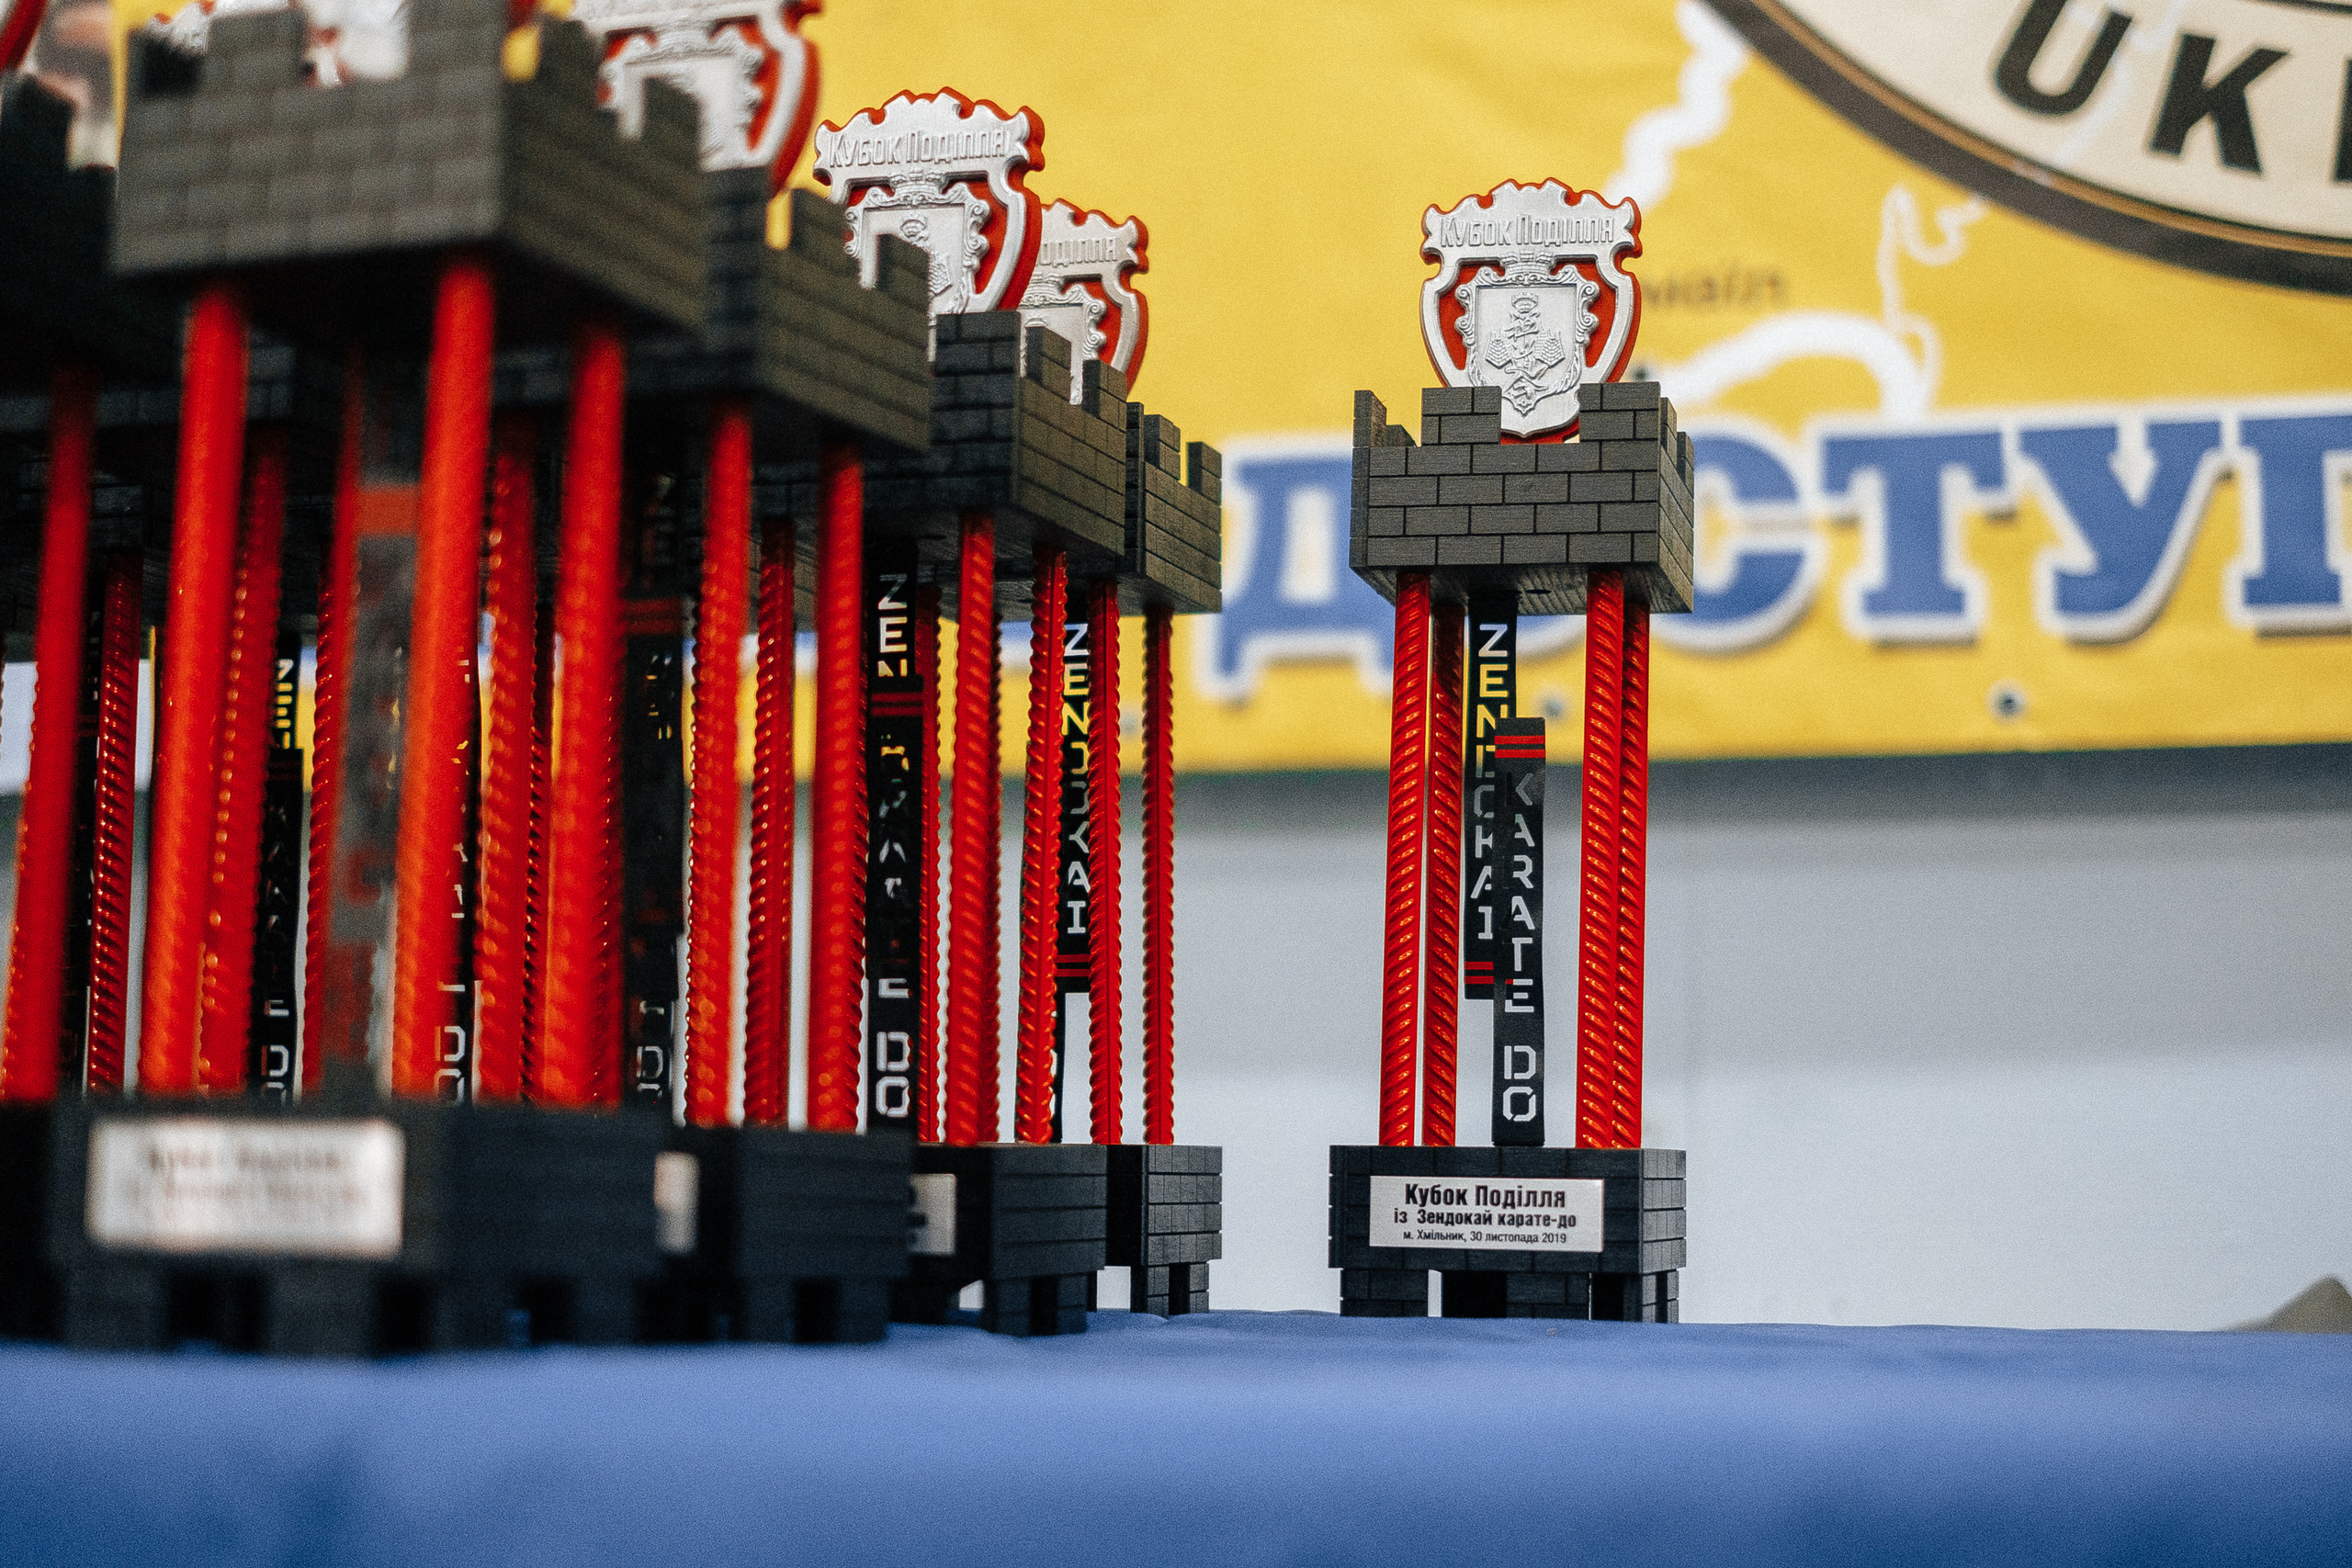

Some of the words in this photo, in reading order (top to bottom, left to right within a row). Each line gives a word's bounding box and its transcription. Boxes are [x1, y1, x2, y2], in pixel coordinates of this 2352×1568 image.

[1996, 0, 2352, 184] UK
[876, 1032, 910, 1118] DO
[1503, 1045, 1536, 1122] DO
[1394, 1208, 1408, 1224] із
[1417, 1209, 1493, 1226] Зендокай
[1497, 1213, 1577, 1229] карате-до
[1405, 1183, 1468, 1207] Кубок
[1475, 1185, 1566, 1210] Поділля
[1403, 1231, 1414, 1240] м.
[1417, 1230, 1467, 1243] Хмільник,
[1470, 1231, 1483, 1241] 30
[1485, 1232, 1539, 1244] листопада
[1542, 1232, 1567, 1244] 2019
